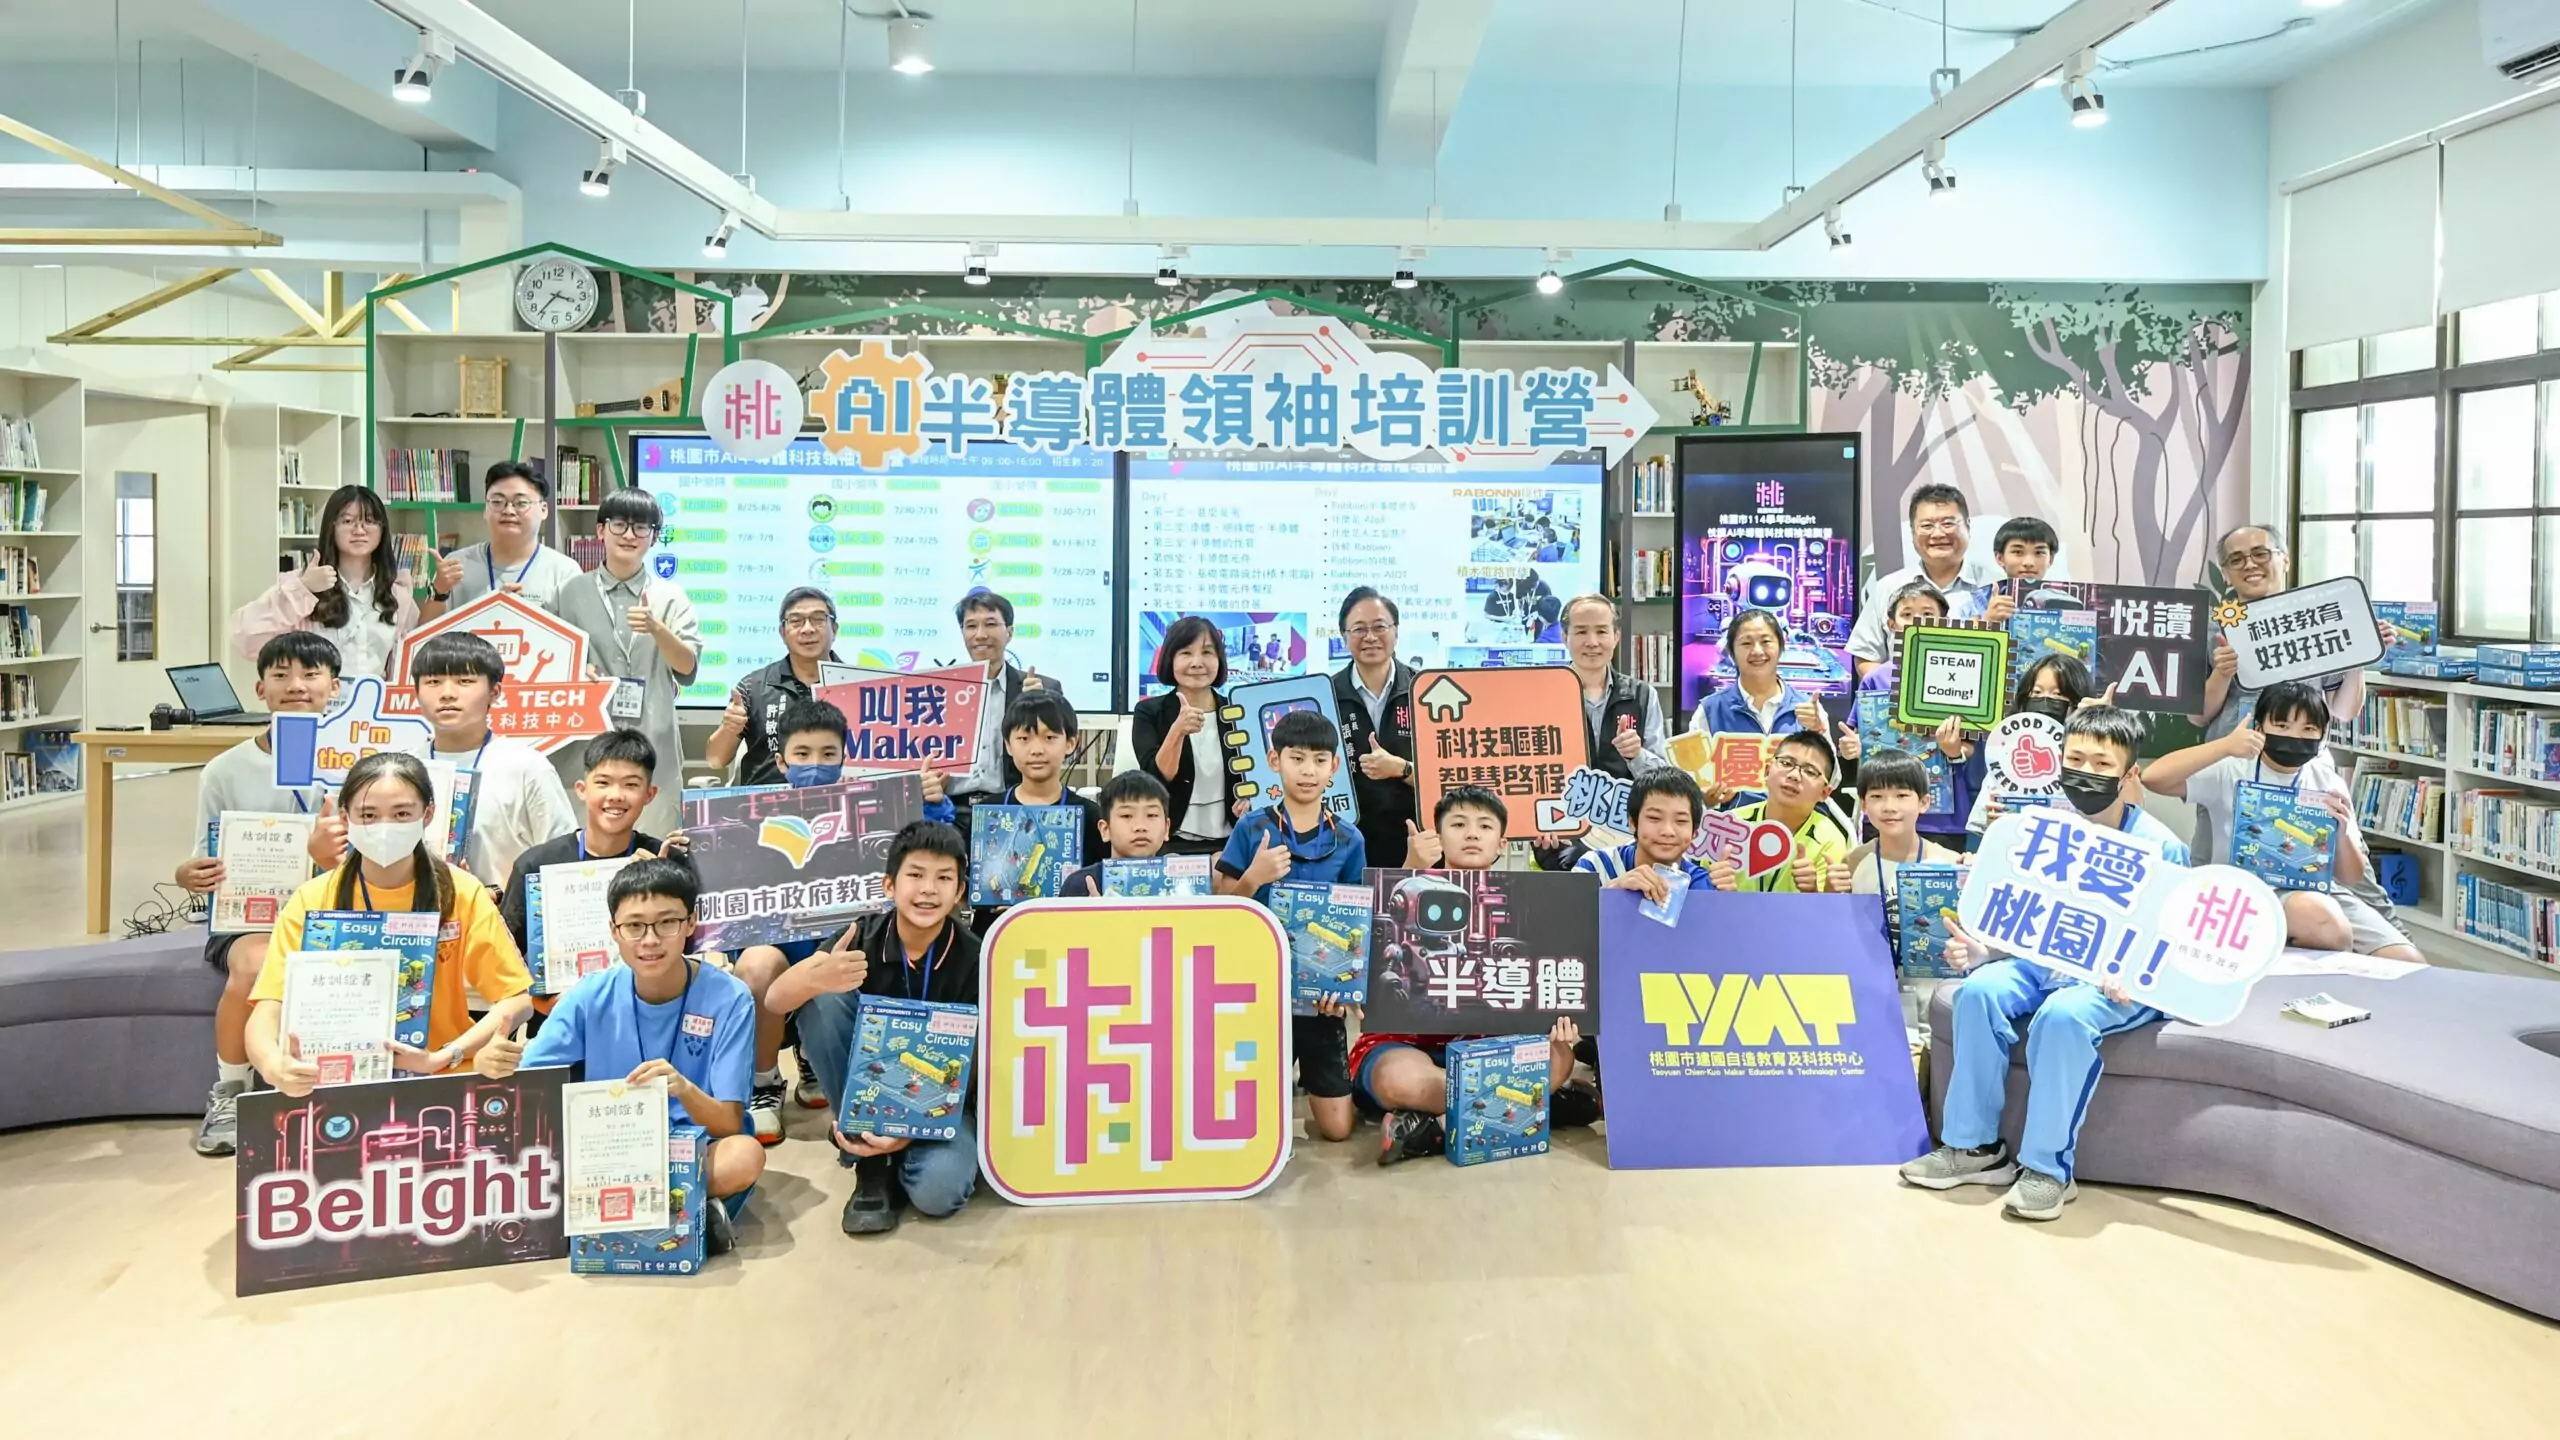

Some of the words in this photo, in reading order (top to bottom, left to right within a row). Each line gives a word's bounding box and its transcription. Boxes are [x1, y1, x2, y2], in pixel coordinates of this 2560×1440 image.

[553, 267, 565, 277] 12
[532, 279, 543, 289] 10
[835, 369, 1594, 453] AI半導體領袖培訓營
[2034, 615, 2057, 626] Easy
[2109, 598, 2195, 641] 悅讀
[2247, 601, 2344, 642] 科技教育
[2060, 625, 2094, 634] Circuits
[2254, 628, 2353, 672] 好好玩!
[1929, 655, 1977, 669] STEAM
[2115, 650, 2180, 698] AI
[518, 689, 586, 708] TECH
[1927, 685, 1975, 700] Coding!
[859, 684, 948, 727] 叫我
[2001, 717, 2043, 736] GOOD
[845, 728, 965, 761] Maker
[1436, 725, 1563, 760] 科技驅動
[317, 749, 355, 770] the
[1990, 761, 2019, 792] KEEP
[2023, 787, 2038, 795] IT
[2264, 792, 2291, 805] Easy
[1062, 832, 1074, 858] Easy
[2014, 815, 2151, 909] 我愛
[1132, 867, 1160, 880] Easy
[1925, 879, 1953, 890] Easy
[1298, 892, 1325, 905] Easy
[1327, 905, 1368, 917] Circuits
[341, 922, 377, 936] Easy
[381, 935, 432, 947] Circuits
[1427, 957, 1586, 1011] 半導體
[891, 1018, 923, 1034] Easy
[924, 1033, 970, 1047] Circuits
[1484, 1058, 1509, 1068] Easy
[1649, 1050, 1864, 1067] 桃園市建國自造教育及科技中心
[1512, 1062, 1547, 1074] Circuits
[1651, 1068, 1682, 1077] Taoyuan
[1724, 1068, 1746, 1077] Maker
[1749, 1068, 1785, 1077] Education
[1797, 1067, 1838, 1077] Technology
[1841, 1067, 1866, 1076] Center
[256, 1153, 554, 1244] Belight
